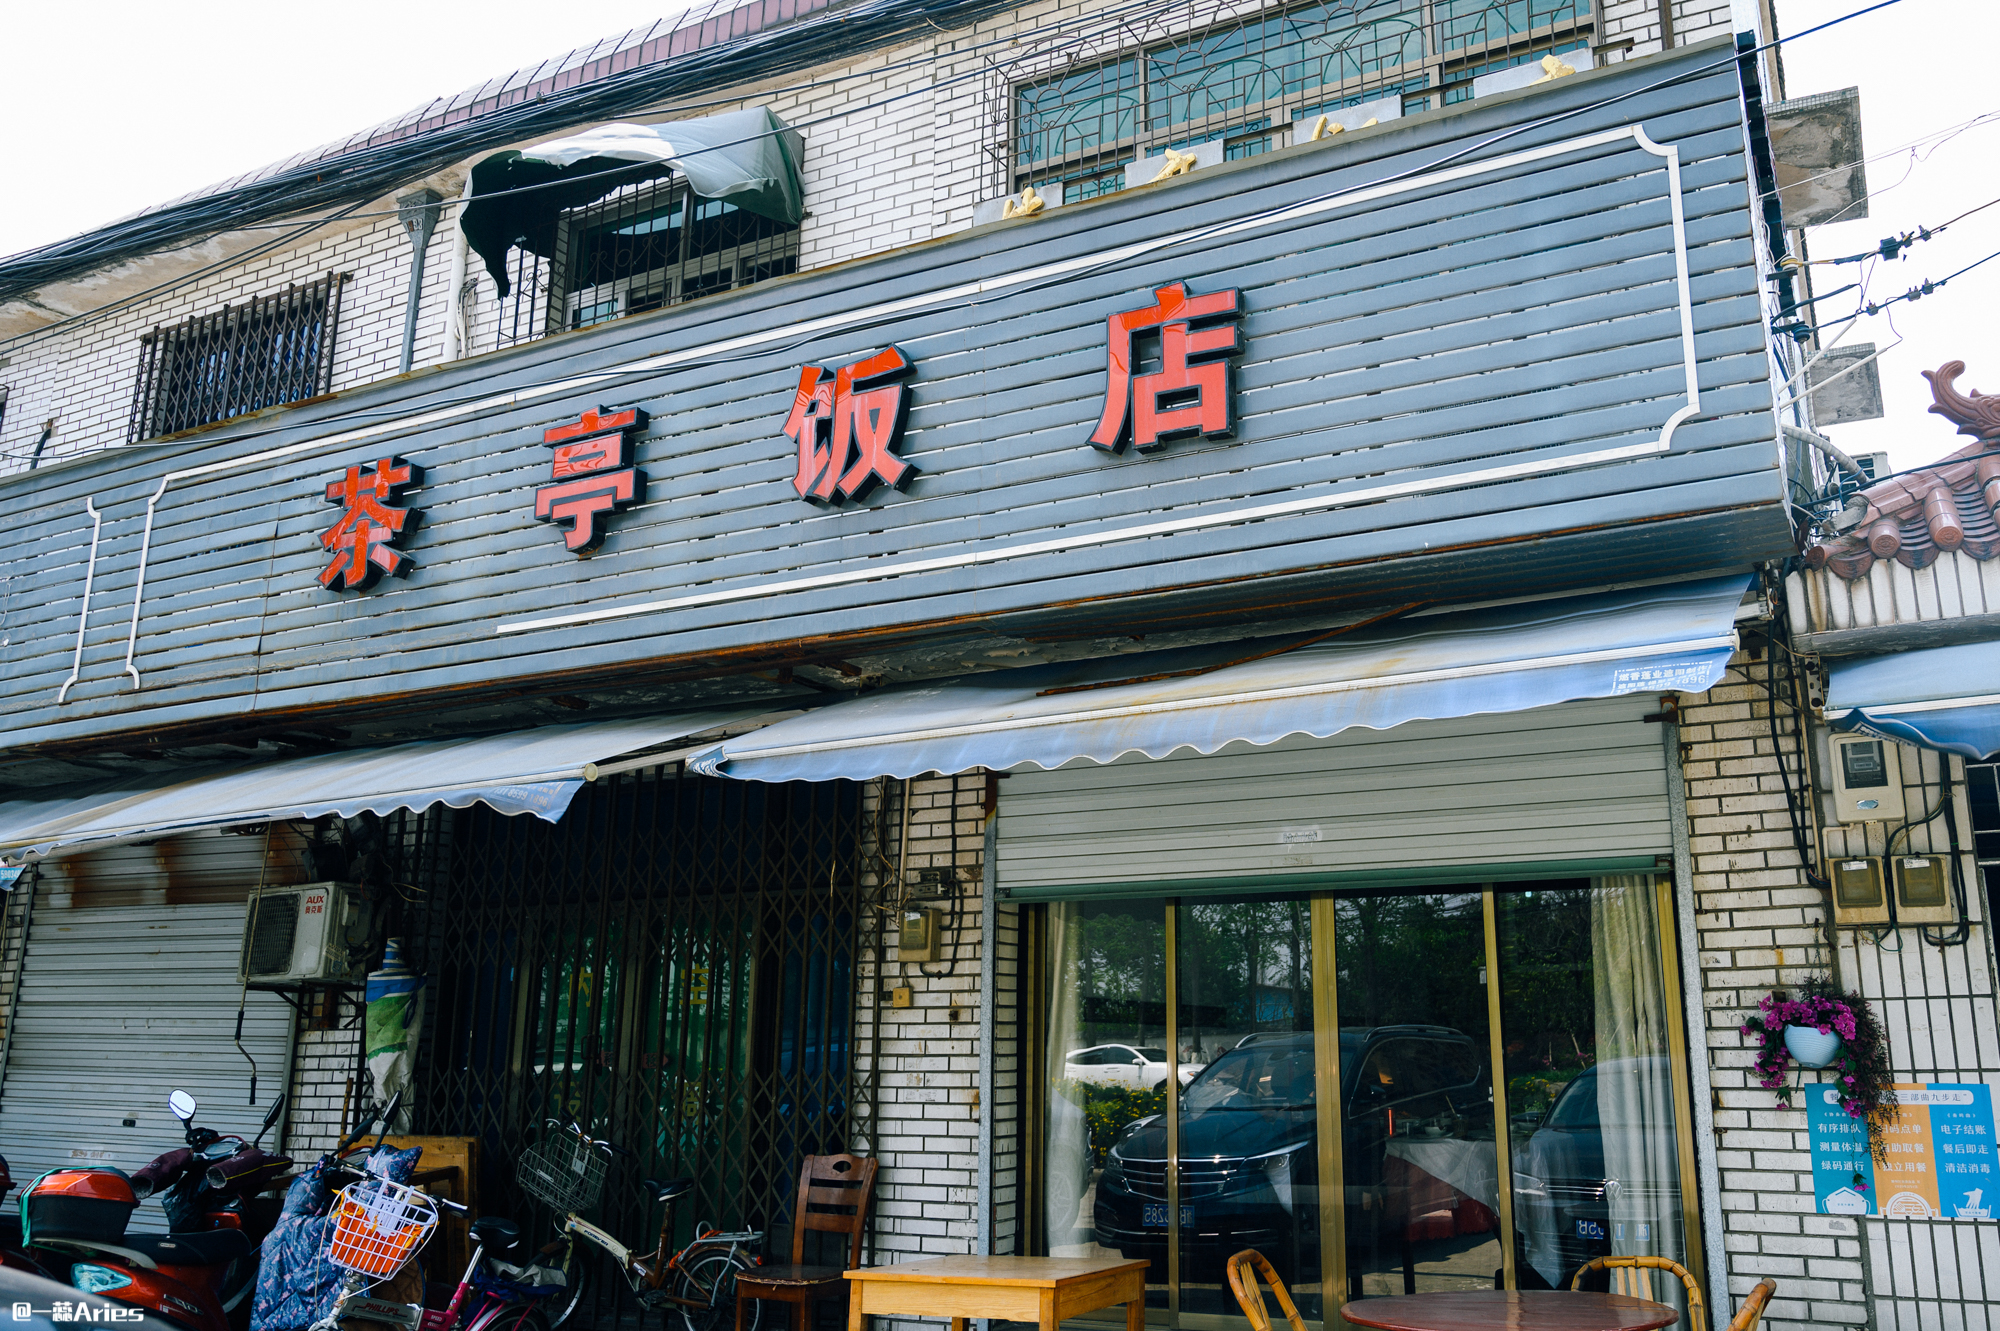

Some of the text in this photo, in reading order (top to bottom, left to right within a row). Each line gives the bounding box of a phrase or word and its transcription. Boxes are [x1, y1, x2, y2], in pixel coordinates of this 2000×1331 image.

[316, 279, 1244, 592] 茶亭饭店
[1676, 674, 1706, 684] 1896
[508, 788, 528, 801] 8599
[529, 793, 549, 807] 1896
[305, 895, 324, 904] AUX
[304, 905, 323, 914] 奥克斯
[1817, 1122, 1862, 1134] 有序排队
[1940, 1124, 1987, 1135] 电子结账
[1818, 1141, 1863, 1152] 测量体温
[1942, 1143, 1989, 1154] 餐后即走
[1821, 1160, 1865, 1171] 绿码通行
[1944, 1162, 1991, 1174] 清洁消毒
[583, 1229, 609, 1246] FOREVER
[364, 1302, 399, 1315] PHILLIPS
